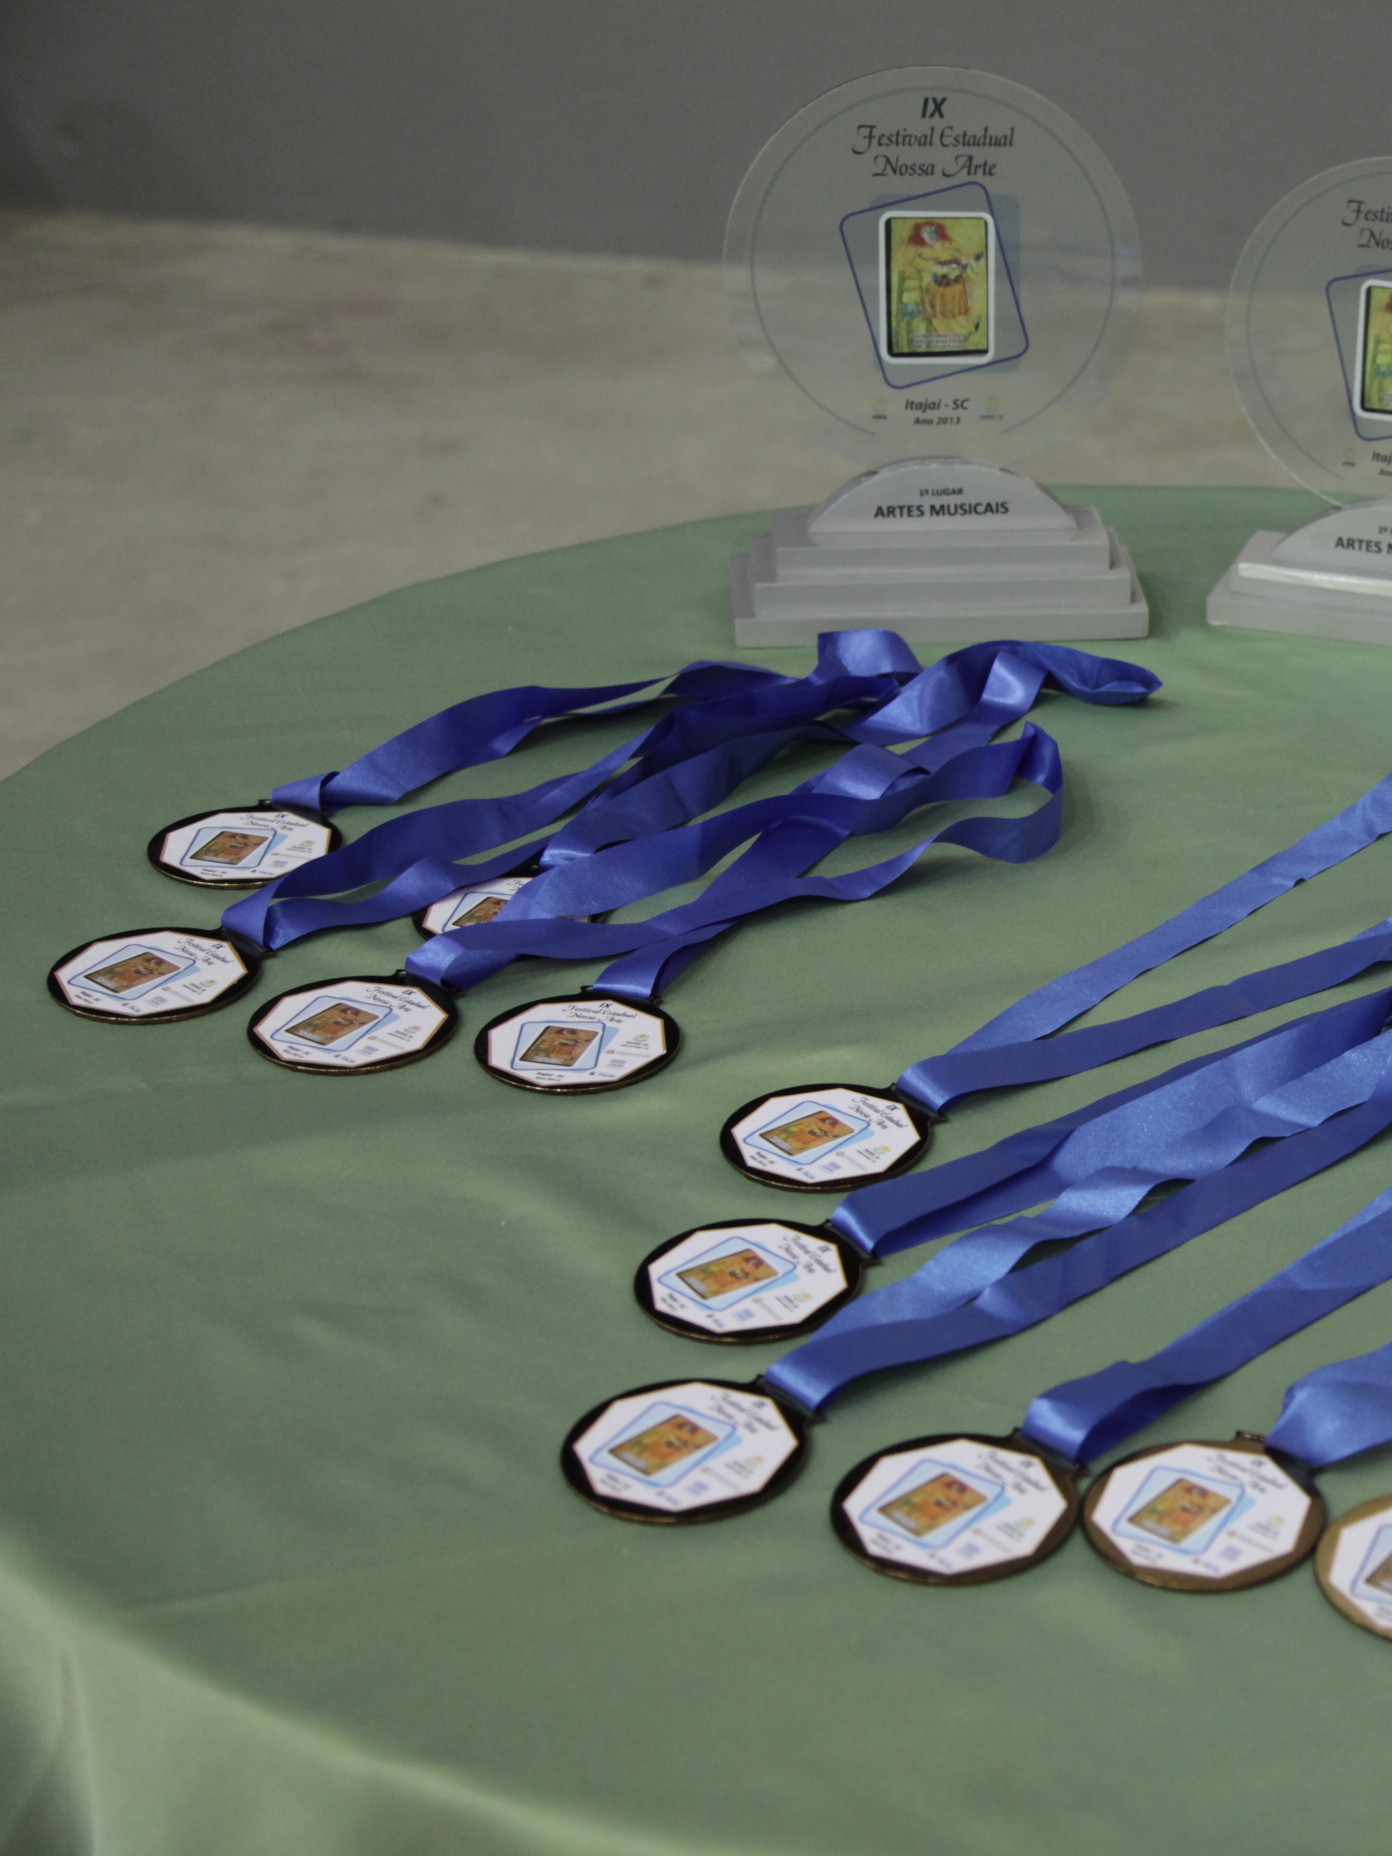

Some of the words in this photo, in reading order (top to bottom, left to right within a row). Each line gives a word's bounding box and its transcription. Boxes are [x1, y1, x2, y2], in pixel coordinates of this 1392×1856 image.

[921, 97, 947, 118] IX
[852, 125, 935, 154] Festival
[940, 126, 1014, 147] Estadual
[872, 154, 935, 177] Nossa
[942, 154, 996, 177] Arte
[952, 398, 970, 411] SC
[913, 416, 933, 425] Ano
[936, 416, 960, 426] 2013
[931, 488, 963, 497] LUGAR
[874, 504, 924, 518] ARTES
[929, 501, 1009, 517] MUSICAIS
[1334, 537, 1382, 554] ARTES
